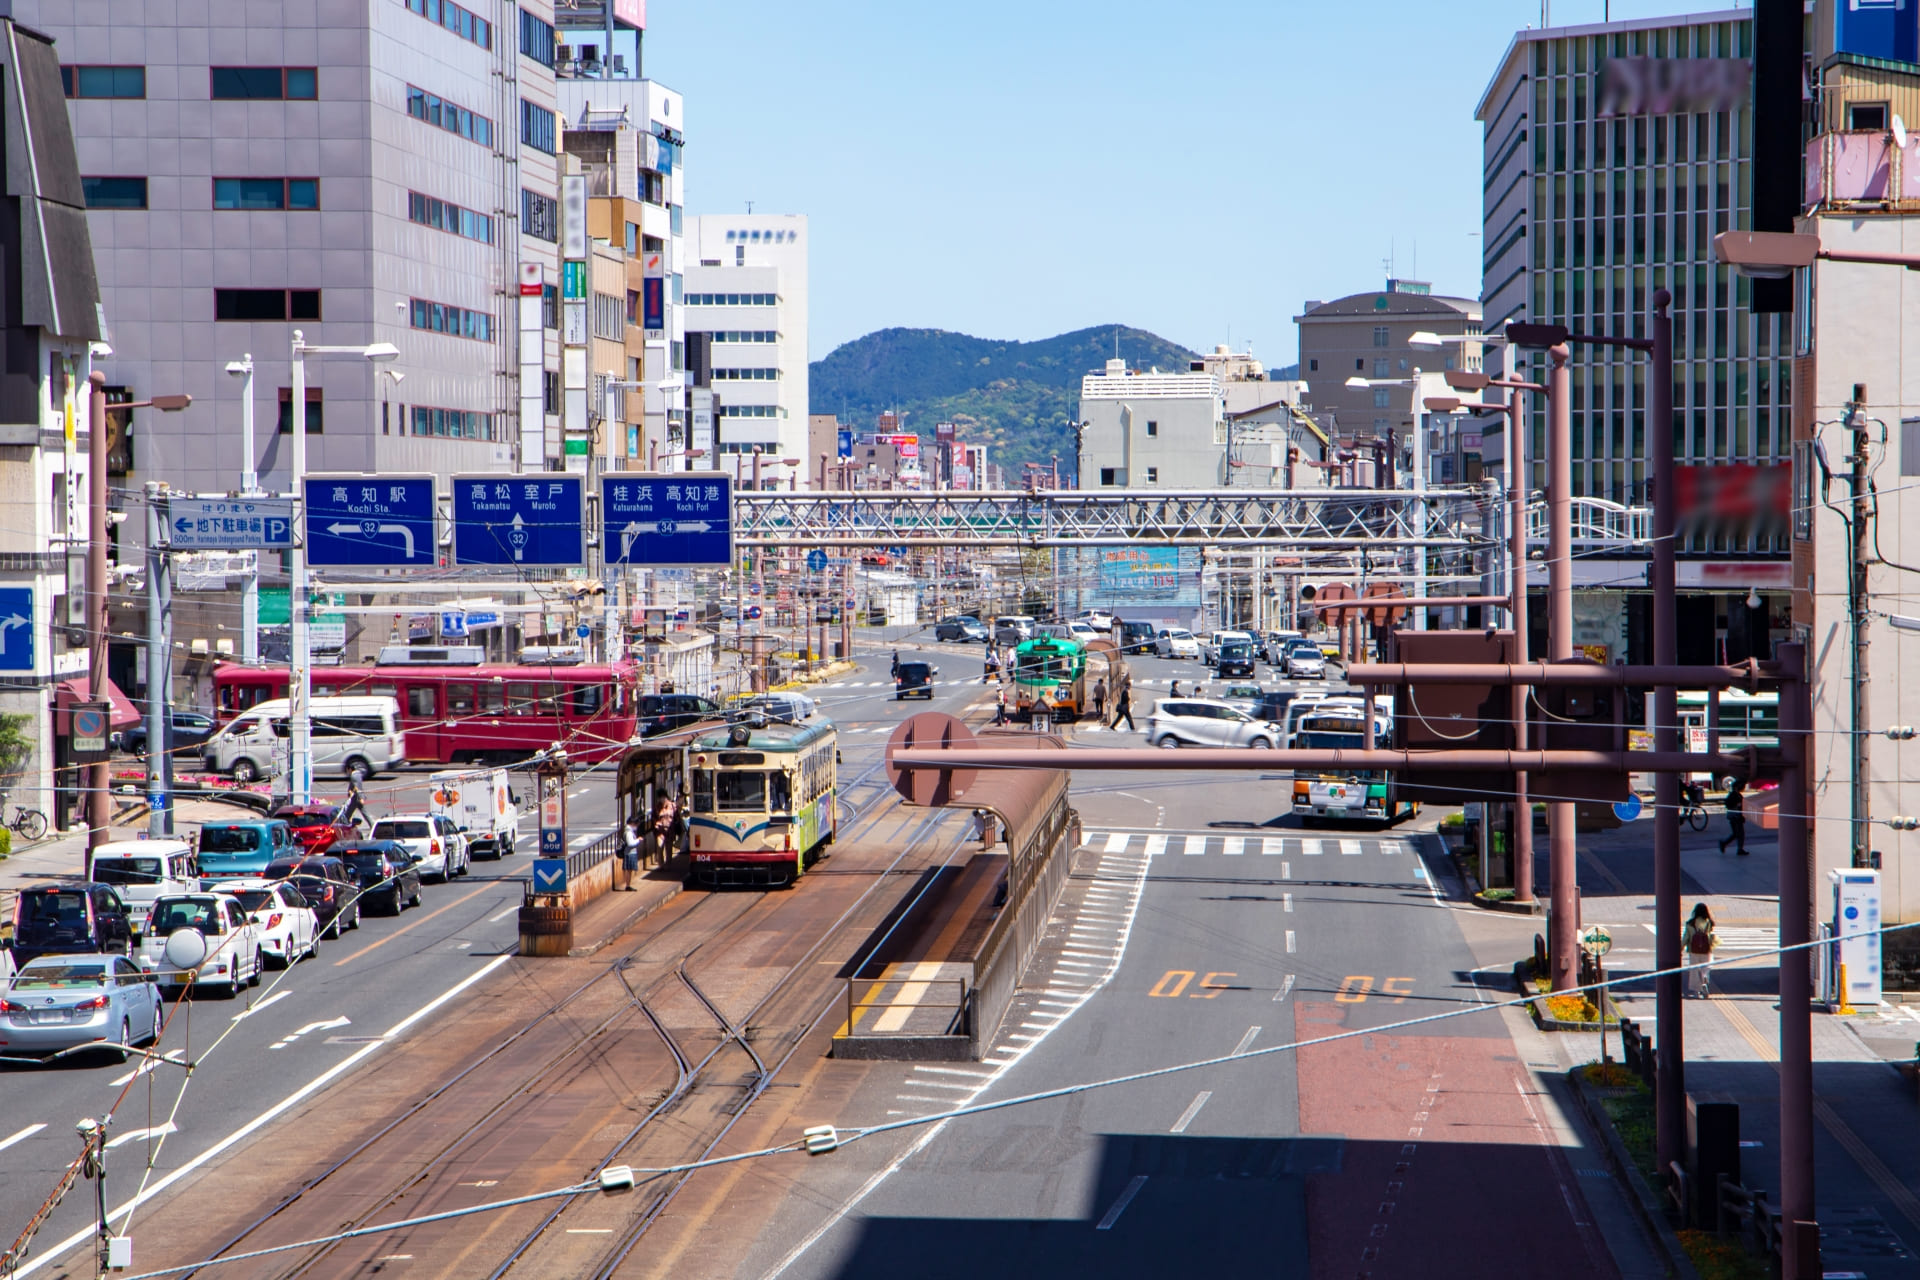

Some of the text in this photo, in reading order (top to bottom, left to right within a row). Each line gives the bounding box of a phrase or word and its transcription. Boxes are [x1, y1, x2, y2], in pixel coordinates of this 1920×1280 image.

[332, 487, 406, 503] 高知駅
[471, 483, 564, 500] 高松 室戸
[613, 485, 720, 501] 桂浜 高知港
[202, 503, 255, 513] はりまや
[348, 504, 391, 513] Kochi Sta.
[472, 501, 557, 510] Takamatsu Muroto
[613, 503, 709, 512] Katsurahama Kochi Port
[197, 517, 262, 533] 地下駐車場
[270, 520, 286, 540] P
[364, 522, 376, 532] 32
[661, 522, 673, 533] 34
[174, 534, 194, 544] 500m
[198, 534, 261, 545] Harimaya Underground Parking
[513, 534, 523, 544] 32
[1153, 576, 1174, 587] 119
[696, 854, 711, 862] 804
